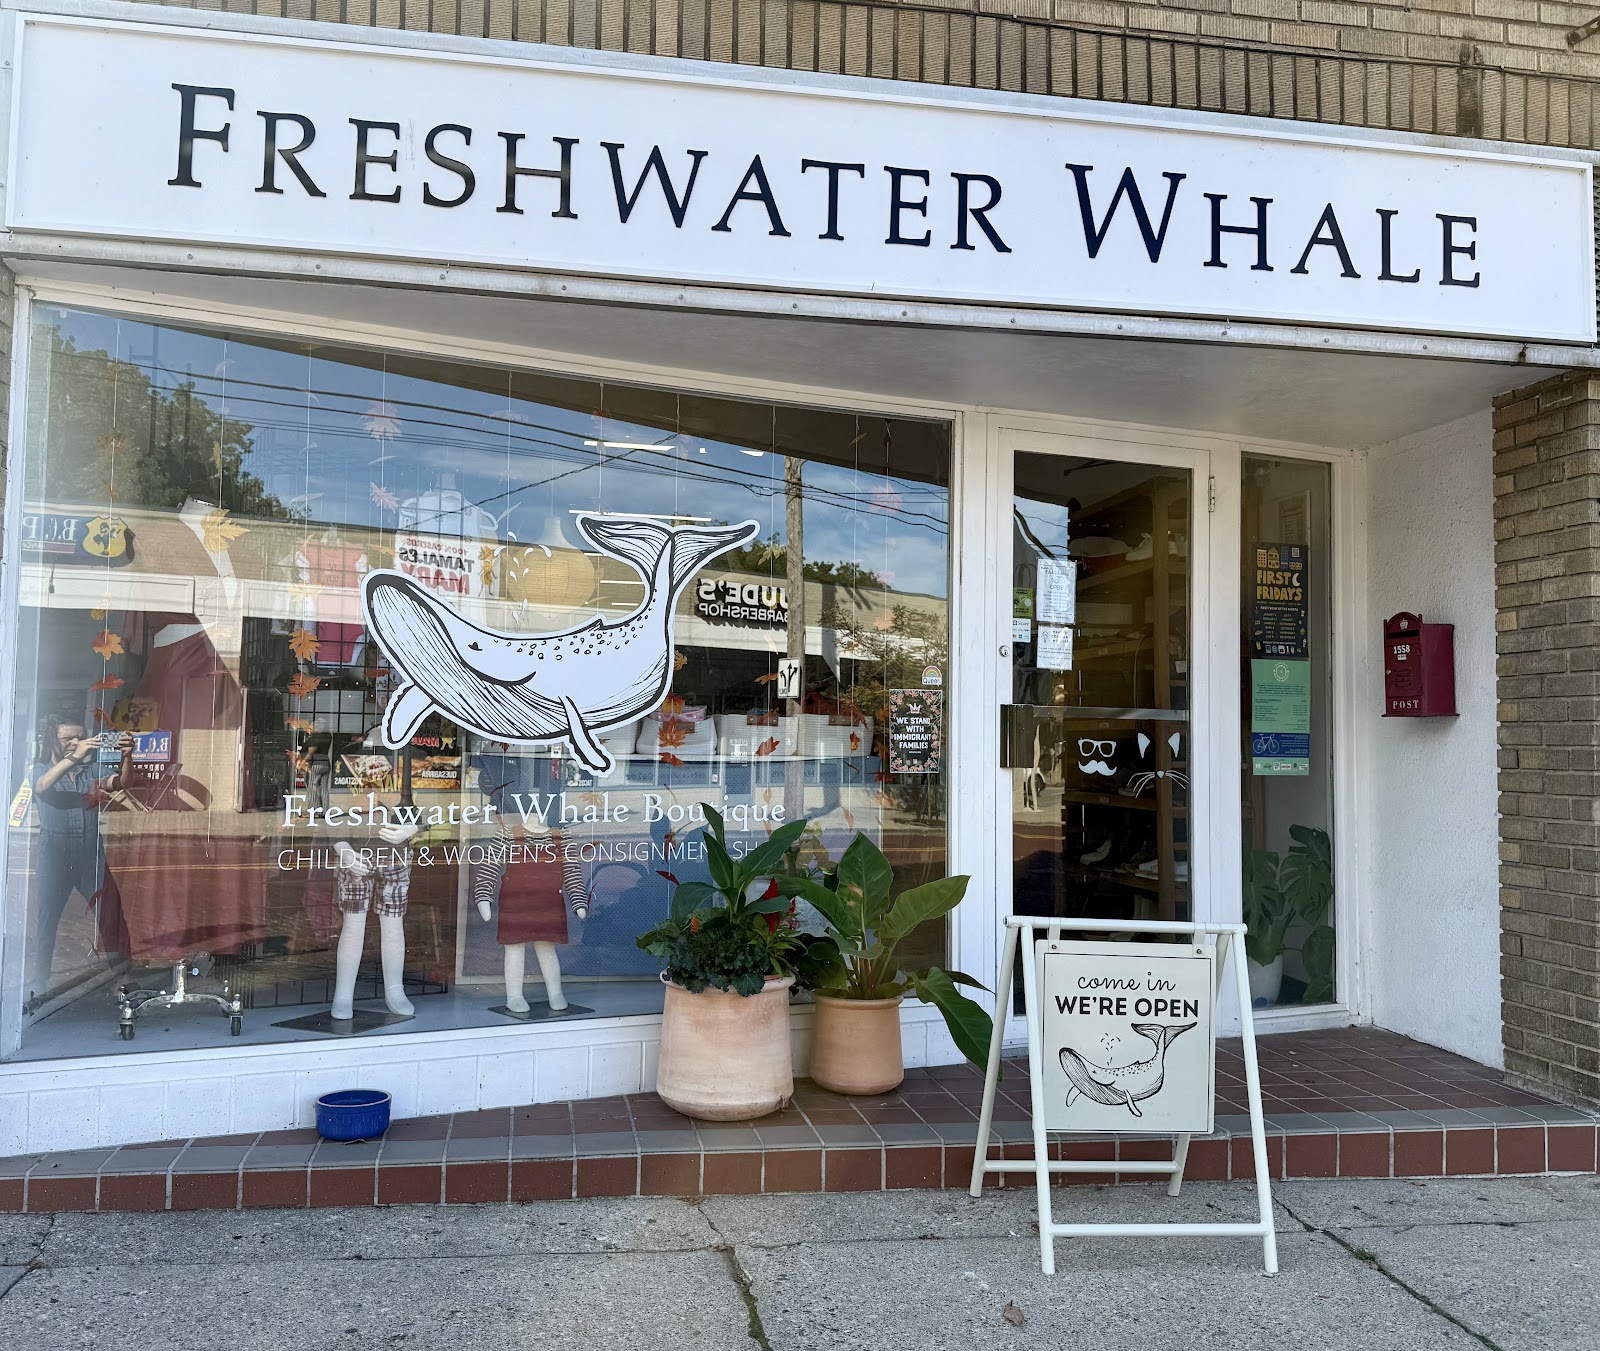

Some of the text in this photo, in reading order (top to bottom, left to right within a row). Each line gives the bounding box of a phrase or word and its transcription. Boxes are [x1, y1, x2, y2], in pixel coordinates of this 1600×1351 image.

[167, 82, 1481, 289] FRESHWATER WHALE
[1256, 569, 1291, 585] FIRST
[1256, 585, 1303, 601] FRIDAYS
[1393, 644, 1411, 654] 1558
[1392, 699, 1419, 710] POST
[896, 717, 931, 725] WE STAND
[905, 725, 925, 733] WITH
[893, 733, 932, 741] IMMIGRANT
[898, 741, 929, 749] FAMILIES
[281, 791, 497, 827] Freshwater
[510, 791, 630, 825] Whale
[277, 846, 408, 871] CHILDREN
[417, 845, 435, 867] &
[443, 842, 557, 866] WOMEN'S
[1076, 971, 1177, 992] come in
[1054, 995, 1199, 1018] WE'RE OPEN
